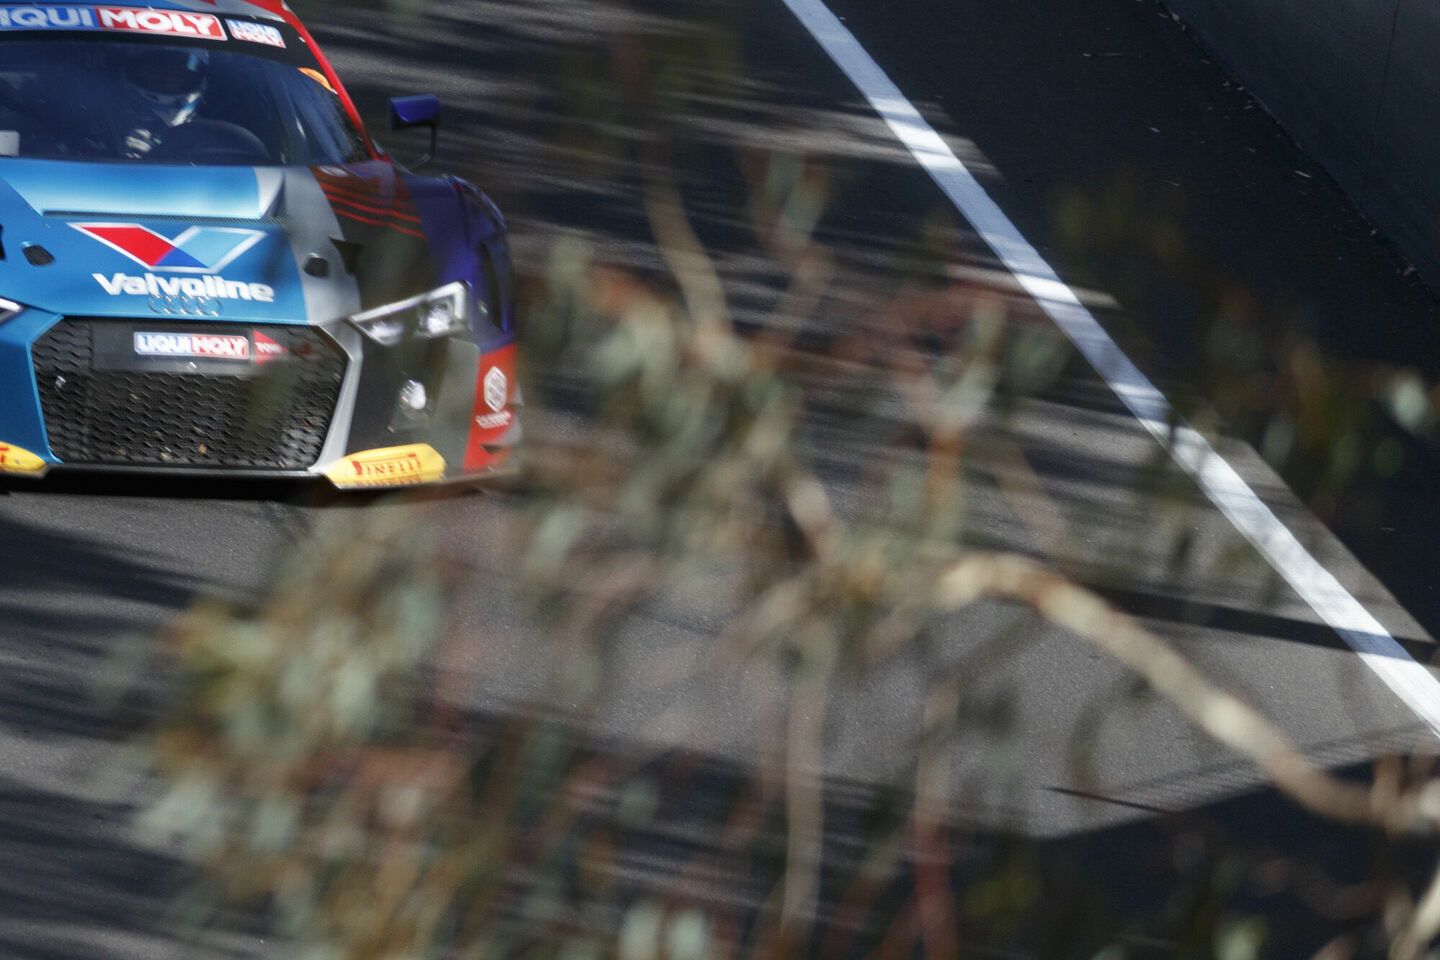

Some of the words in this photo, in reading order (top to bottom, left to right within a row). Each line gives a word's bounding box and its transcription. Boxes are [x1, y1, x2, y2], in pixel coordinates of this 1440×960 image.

[98, 8, 215, 35] MOLY
[91, 272, 274, 302] Valvoline
[136, 335, 191, 353] LIQUI
[192, 337, 248, 355] MOLY
